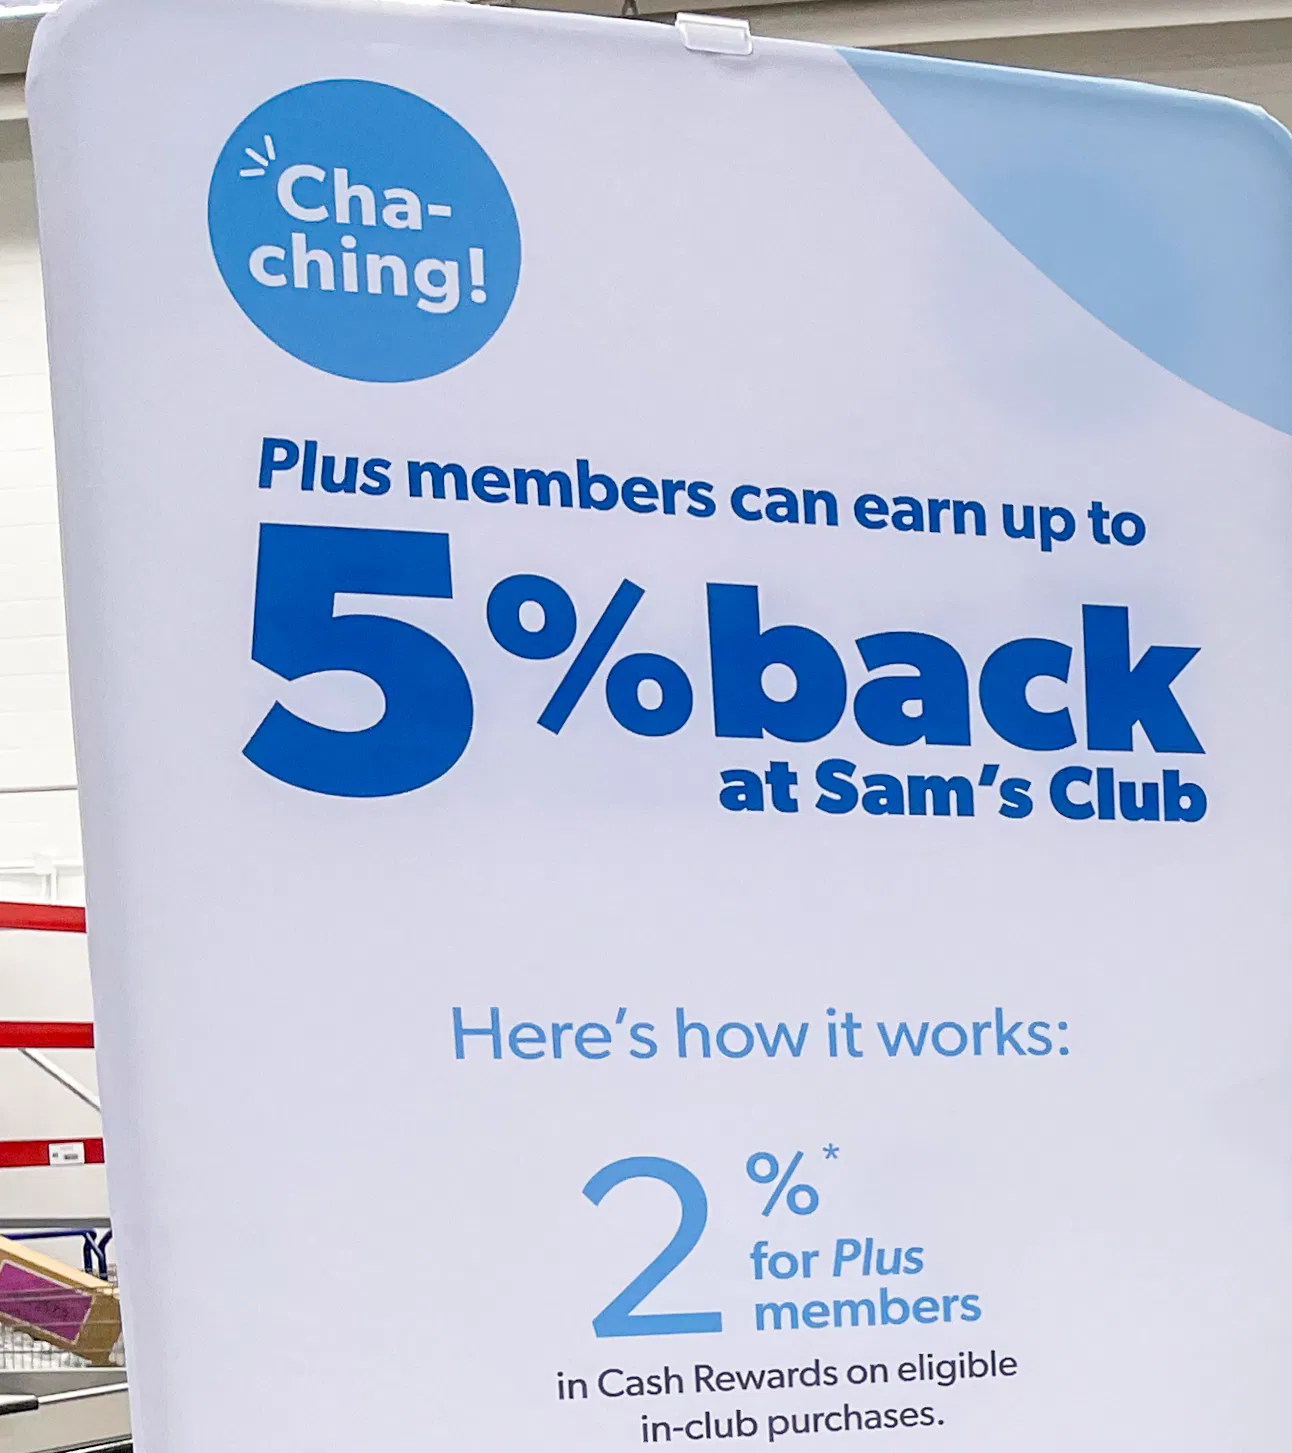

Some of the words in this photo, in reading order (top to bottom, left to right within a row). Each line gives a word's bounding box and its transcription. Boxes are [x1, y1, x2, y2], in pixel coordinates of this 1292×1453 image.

[278, 165, 451, 230] Cha-
[249, 232, 486, 313] ching!
[259, 437, 391, 495] Plus
[407, 459, 716, 517] members
[731, 485, 838, 526] can
[854, 494, 986, 536] earn
[1002, 504, 1075, 552] up
[1088, 501, 1145, 546] to
[706, 581, 1207, 754] back
[720, 761, 798, 813] at
[1050, 766, 1207, 822] Club
[676, 1007, 809, 1058] how
[826, 1008, 863, 1057] it
[877, 1007, 1069, 1057] works:
[750, 1241, 819, 1280] for
[833, 1238, 923, 1277] Plus
[755, 1287, 981, 1330] members
[558, 1372, 587, 1399] in
[598, 1366, 683, 1397] Cash
[695, 1359, 838, 1392] Rewards
[847, 1364, 888, 1384] on
[898, 1350, 1017, 1386] eligible
[642, 1410, 757, 1442] in-club
[769, 1404, 944, 1442] purchases.
